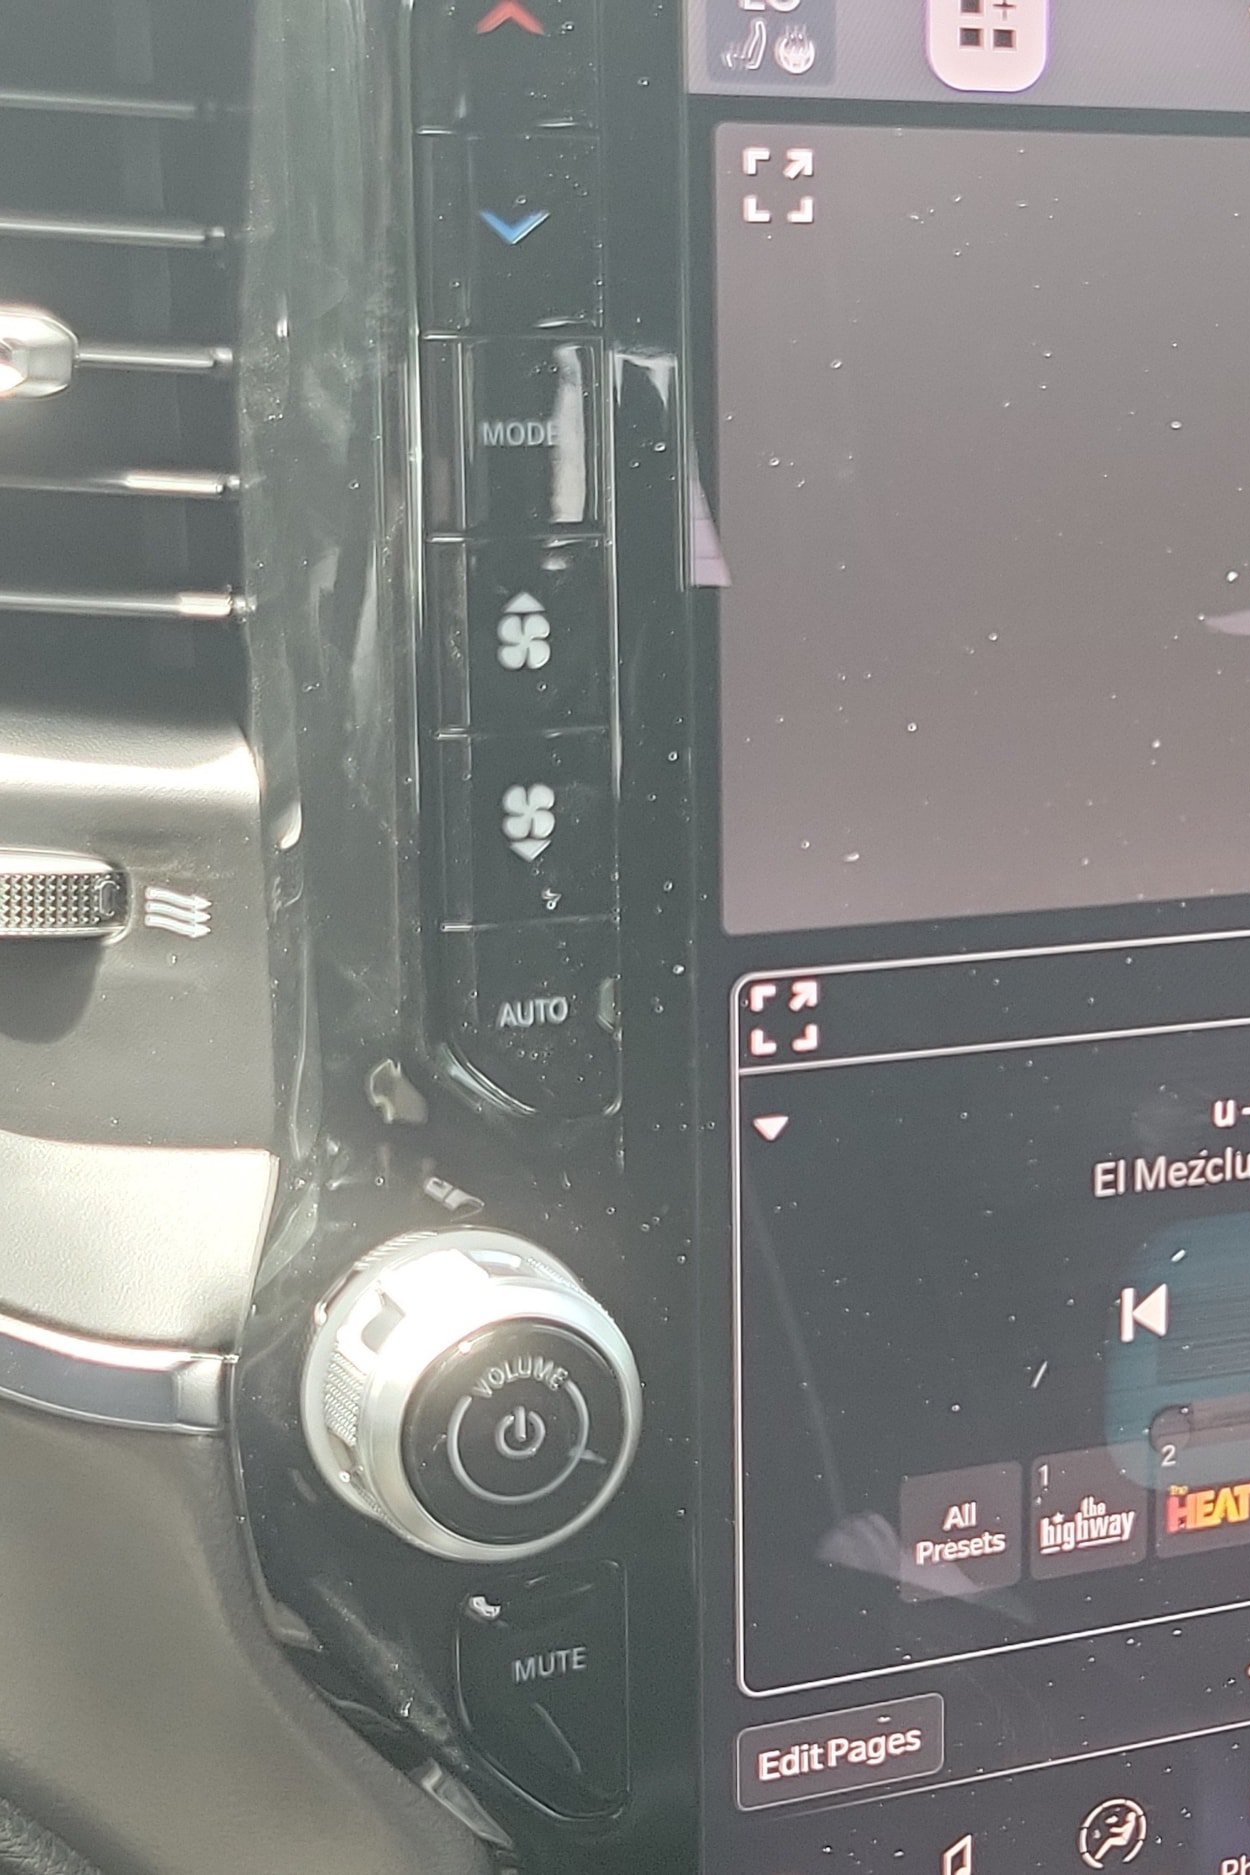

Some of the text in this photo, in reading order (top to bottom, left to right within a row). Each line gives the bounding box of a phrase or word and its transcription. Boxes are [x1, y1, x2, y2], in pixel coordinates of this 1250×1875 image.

[499, 997, 568, 1027] AUTO
[1212, 1099, 1235, 1127] u
[1093, 1162, 1126, 1198] El
[471, 1356, 569, 1399] VOLUME
[1161, 1444, 1177, 1467] 2
[1038, 1464, 1049, 1486] 1
[942, 1501, 977, 1531] All
[1080, 1496, 1106, 1518] the
[1040, 1511, 1135, 1550] highway
[915, 1531, 1006, 1565] Presets
[512, 1648, 588, 1682] MUTE
[757, 1728, 922, 1781] Edit Pages
